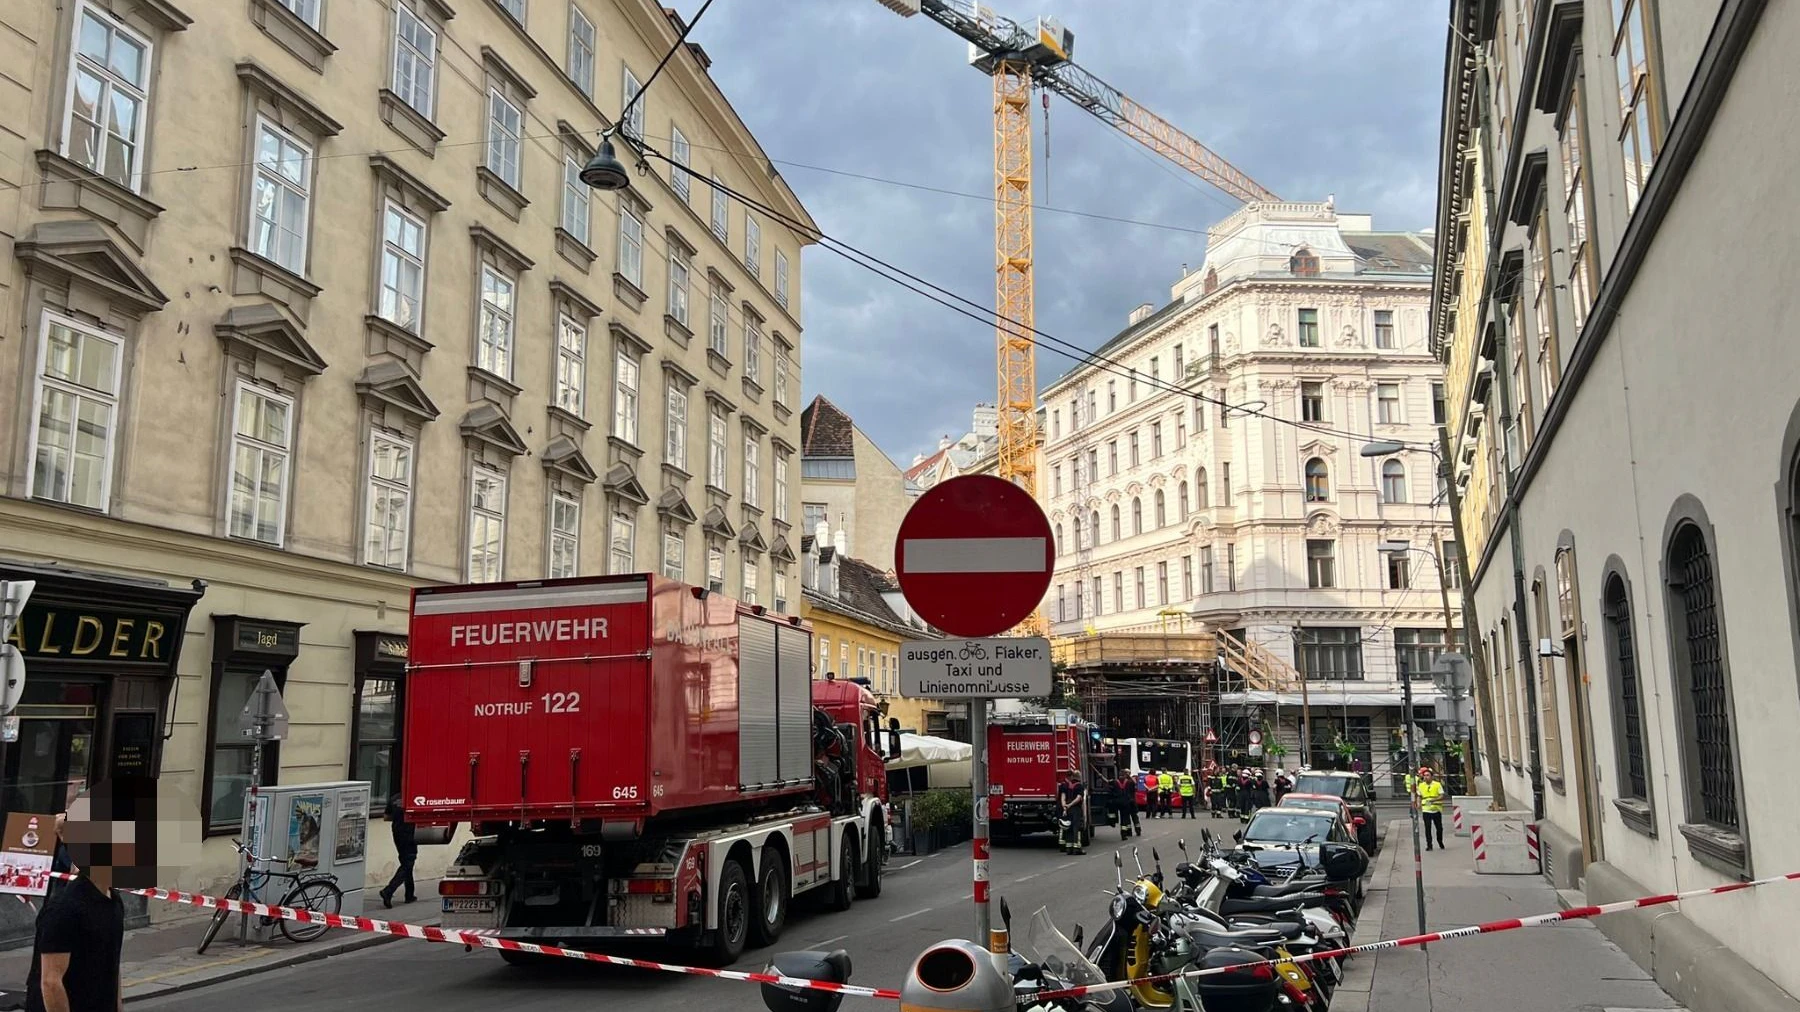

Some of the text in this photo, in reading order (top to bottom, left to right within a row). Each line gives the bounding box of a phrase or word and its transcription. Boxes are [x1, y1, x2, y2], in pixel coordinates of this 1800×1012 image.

[257, 631, 278, 647] Jagd
[451, 618, 608, 647] FEUERWEHR
[907, 649, 957, 663] ausgen.
[945, 663, 1003, 677] Taxi und
[919, 680, 1030, 694] Linienomnibusse
[474, 692, 580, 717] NOTRUF 122
[1007, 741, 1050, 751] FEUERWEHR
[1036, 753, 1051, 764] 122
[612, 786, 638, 800] 645
[653, 784, 664, 797] 645
[426, 796, 466, 806] rosenbauer
[581, 844, 602, 857] 169
[459, 899, 479, 909] 2229
